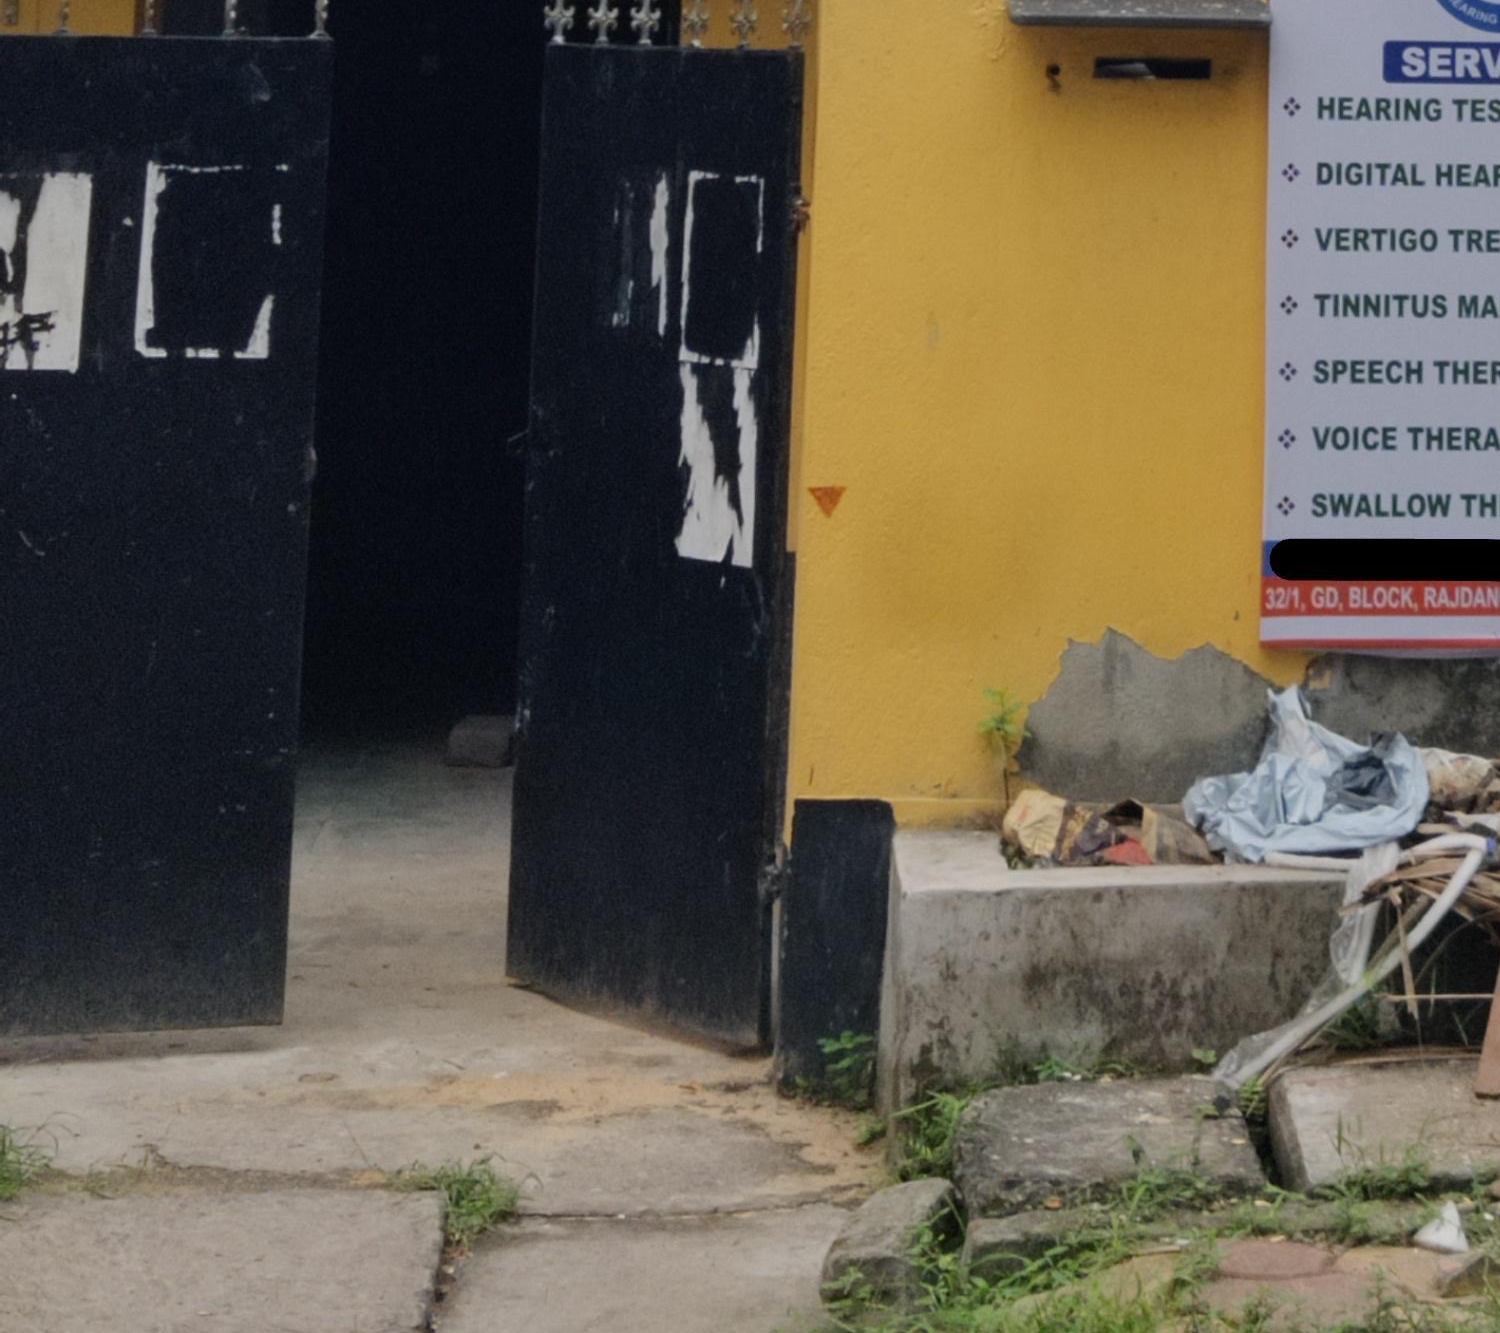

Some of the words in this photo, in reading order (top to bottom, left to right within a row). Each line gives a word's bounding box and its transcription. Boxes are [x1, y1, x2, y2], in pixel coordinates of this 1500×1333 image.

[1317, 96, 1443, 123] HEARING
[1316, 162, 1426, 187] DIGITAL
[1315, 228, 1438, 253] VERTIGO
[1314, 293, 1448, 318] TINNITUS
[1313, 360, 1423, 385] SPEECH
[1312, 426, 1398, 451] VOICE
[1311, 493, 1452, 518] SWALLOW
[1265, 587, 1305, 613] 32/1,
[1311, 587, 1344, 612] GD,
[1349, 587, 1418, 613] BLOCK,
